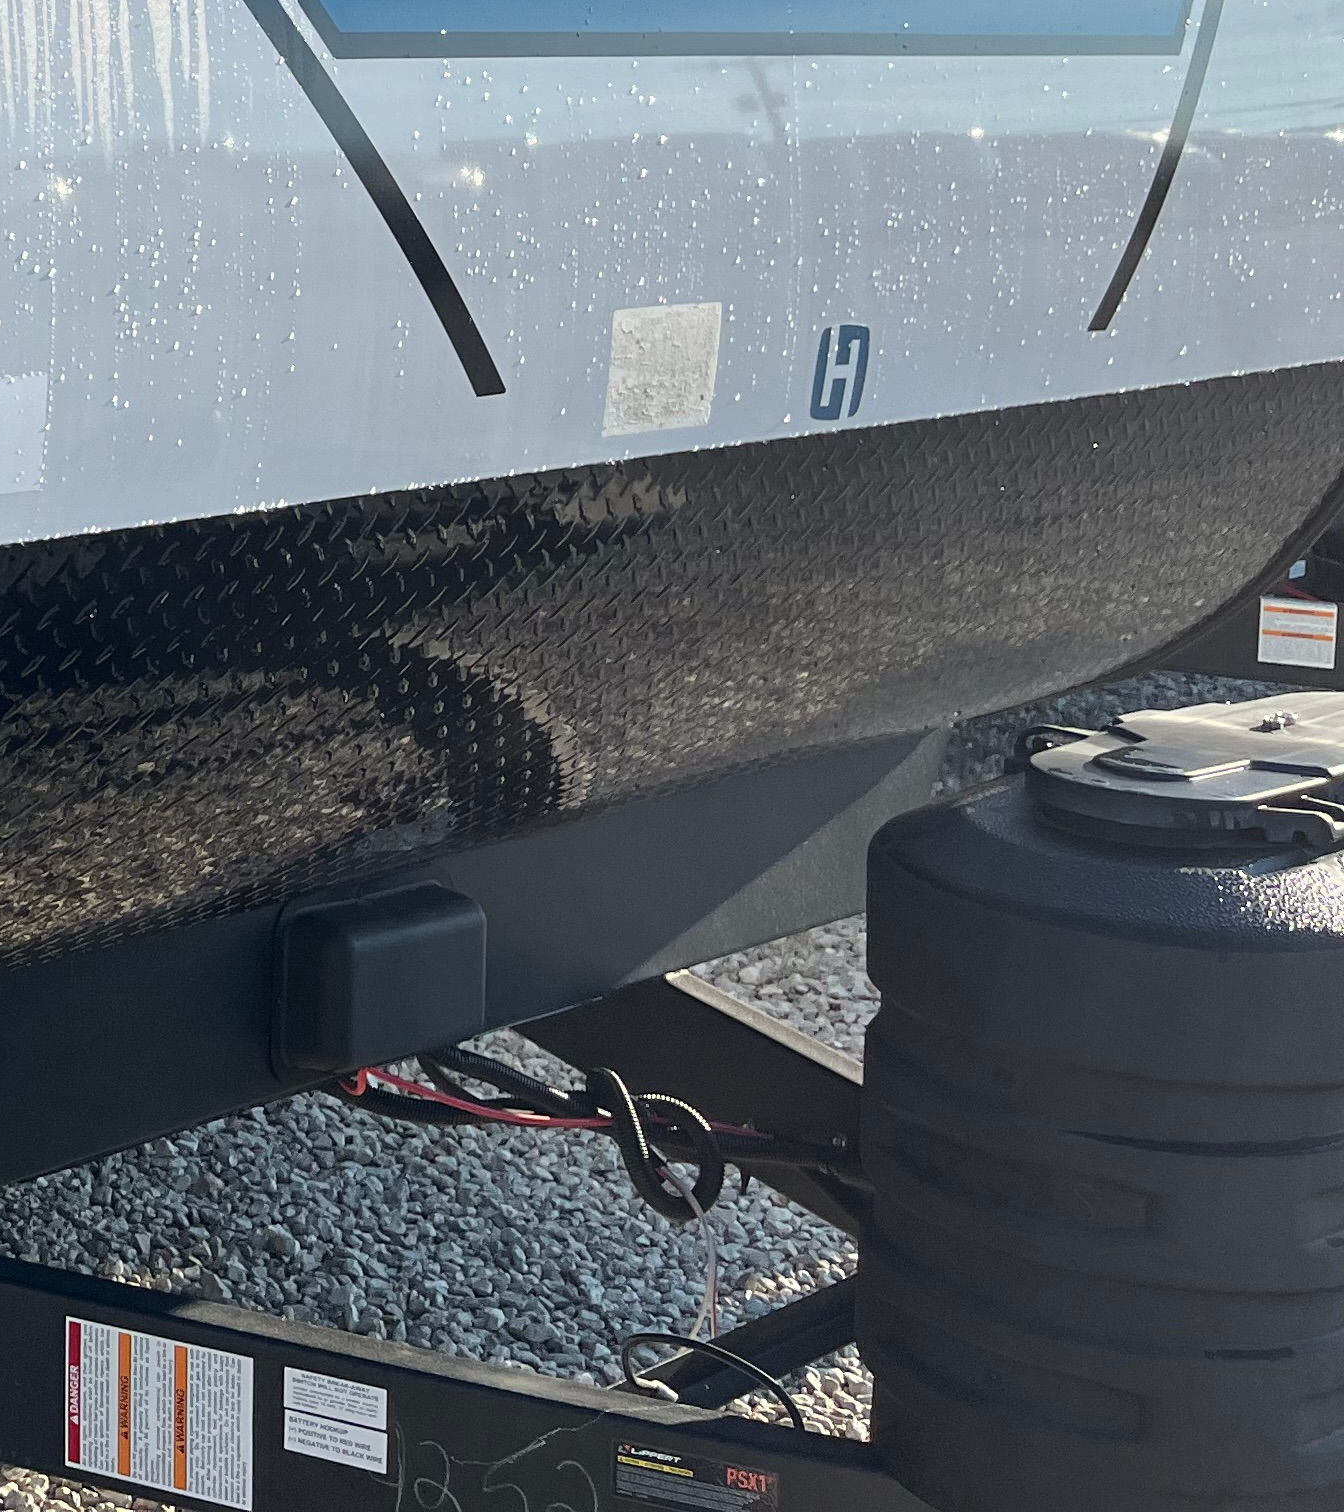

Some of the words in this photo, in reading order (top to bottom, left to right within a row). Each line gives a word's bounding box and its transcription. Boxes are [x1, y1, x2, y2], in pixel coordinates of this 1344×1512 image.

[69, 1365, 80, 1414] DANGER
[120, 1375, 129, 1429] WARNING
[175, 1388, 185, 1443] WARNING
[288, 1415, 319, 1428] BATTERY
[297, 1437, 330, 1451] NEGATIVE
[331, 1445, 341, 1454] TO
[342, 1449, 365, 1459] BLACK
[366, 1454, 383, 1464] WIRE
[298, 1428, 327, 1440] POSITIVE
[329, 1435, 339, 1443] TO
